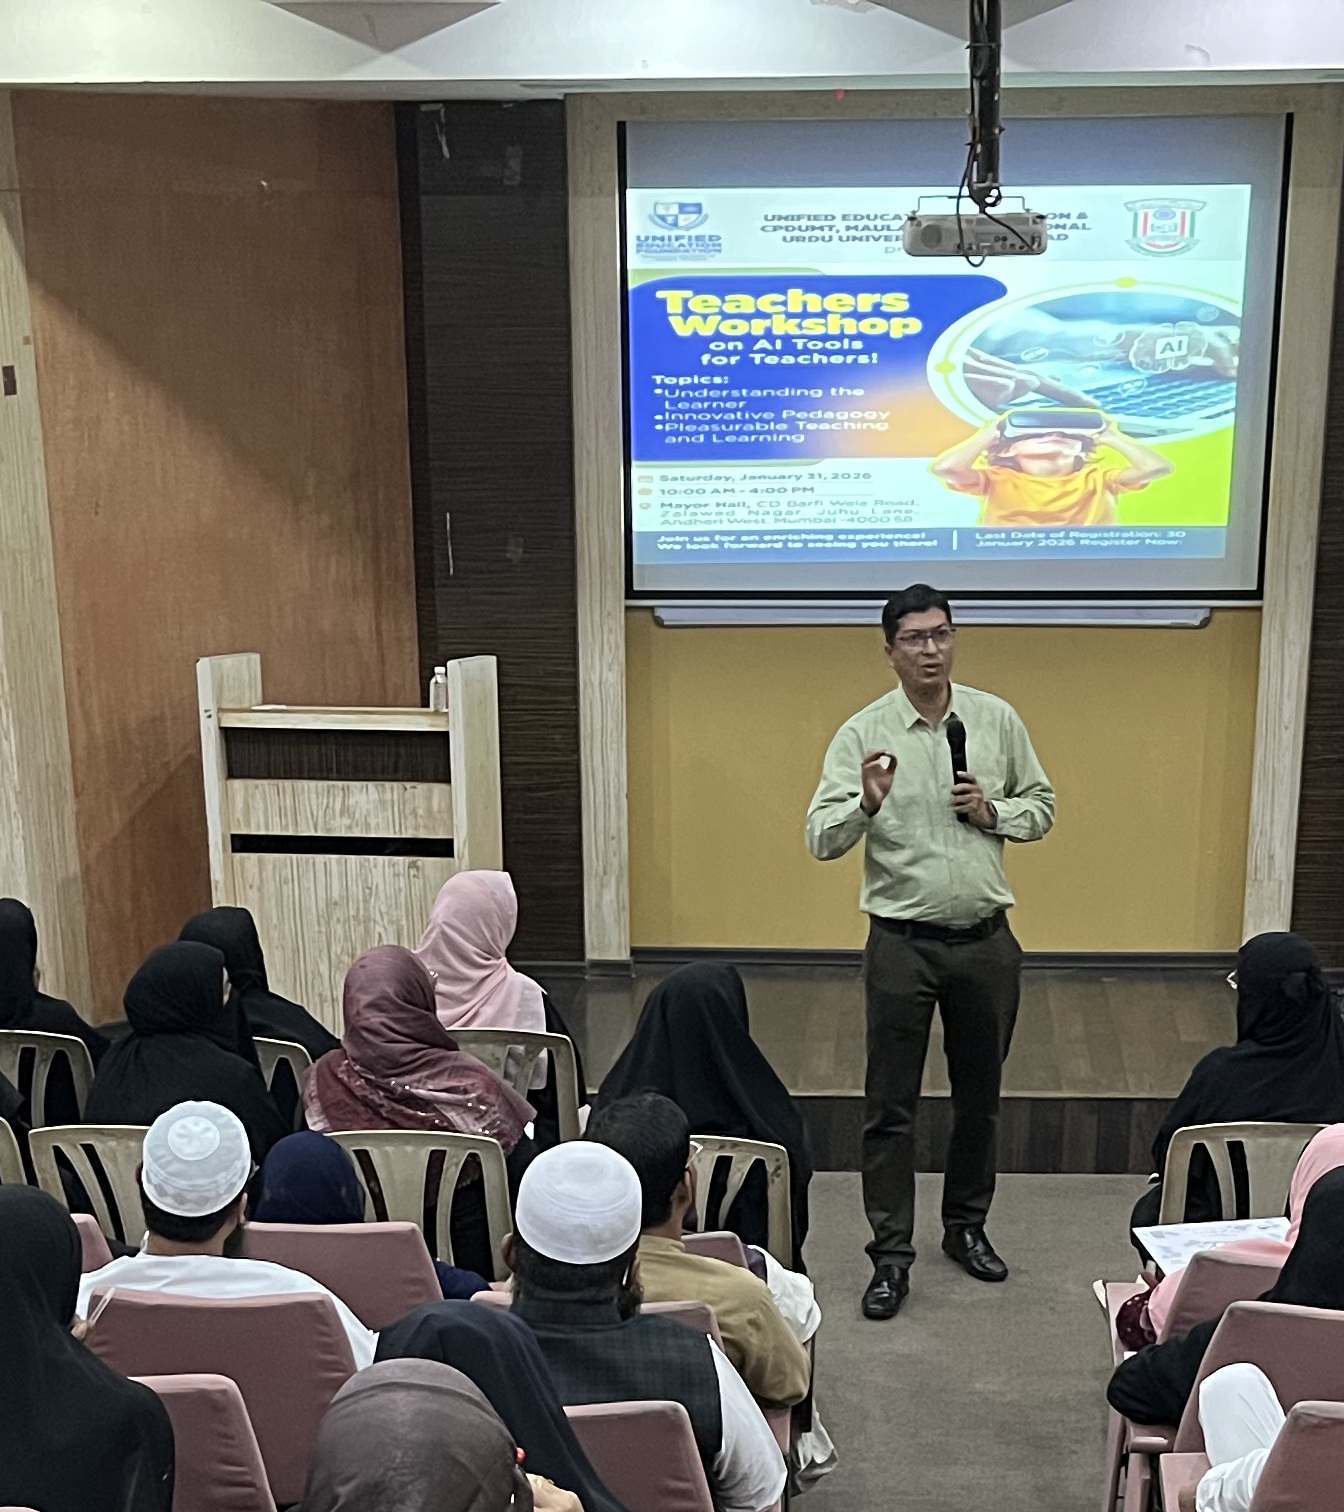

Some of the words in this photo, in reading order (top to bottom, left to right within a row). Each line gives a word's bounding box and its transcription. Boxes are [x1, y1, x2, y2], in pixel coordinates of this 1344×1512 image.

[763, 213, 836, 222] UNIFIED
[635, 234, 722, 243] UNIFIED
[782, 234, 833, 243] URDU
[656, 288, 910, 314] Teachers
[668, 313, 922, 338] Workshop
[709, 341, 743, 351] on
[753, 339, 782, 350] AI
[792, 339, 864, 350] Tools
[1159, 339, 1183, 355] AI
[701, 354, 741, 365] for
[749, 353, 878, 365] Teachers!
[652, 375, 729, 386] Topics:
[664, 387, 823, 398] Understanding
[830, 387, 865, 397] the
[664, 400, 746, 410] Learner
[665, 410, 775, 421] Innovative
[782, 409, 891, 420] Pedagogy
[665, 421, 788, 433] Pleasurable
[795, 421, 889, 432] Teaching
[664, 433, 705, 444] and
[712, 432, 805, 443] Learning
[659, 474, 735, 483] Saturday,
[739, 473, 803, 482] January
[660, 488, 706, 496] 10:00
[710, 487, 736, 495] AM
[660, 502, 709, 510] Mayor
[715, 501, 751, 509] Hall,
[757, 500, 781, 508] CD
[660, 518, 723, 526] Andheri
[714, 534, 736, 542] for
[763, 533, 834, 541] enriching
[976, 532, 1006, 540] Last
[1011, 531, 1046, 539] Date
[723, 541, 783, 549] forward
[807, 541, 856, 549] seeing
[861, 541, 889, 549] you
[1079, 538, 1140, 547] Register
